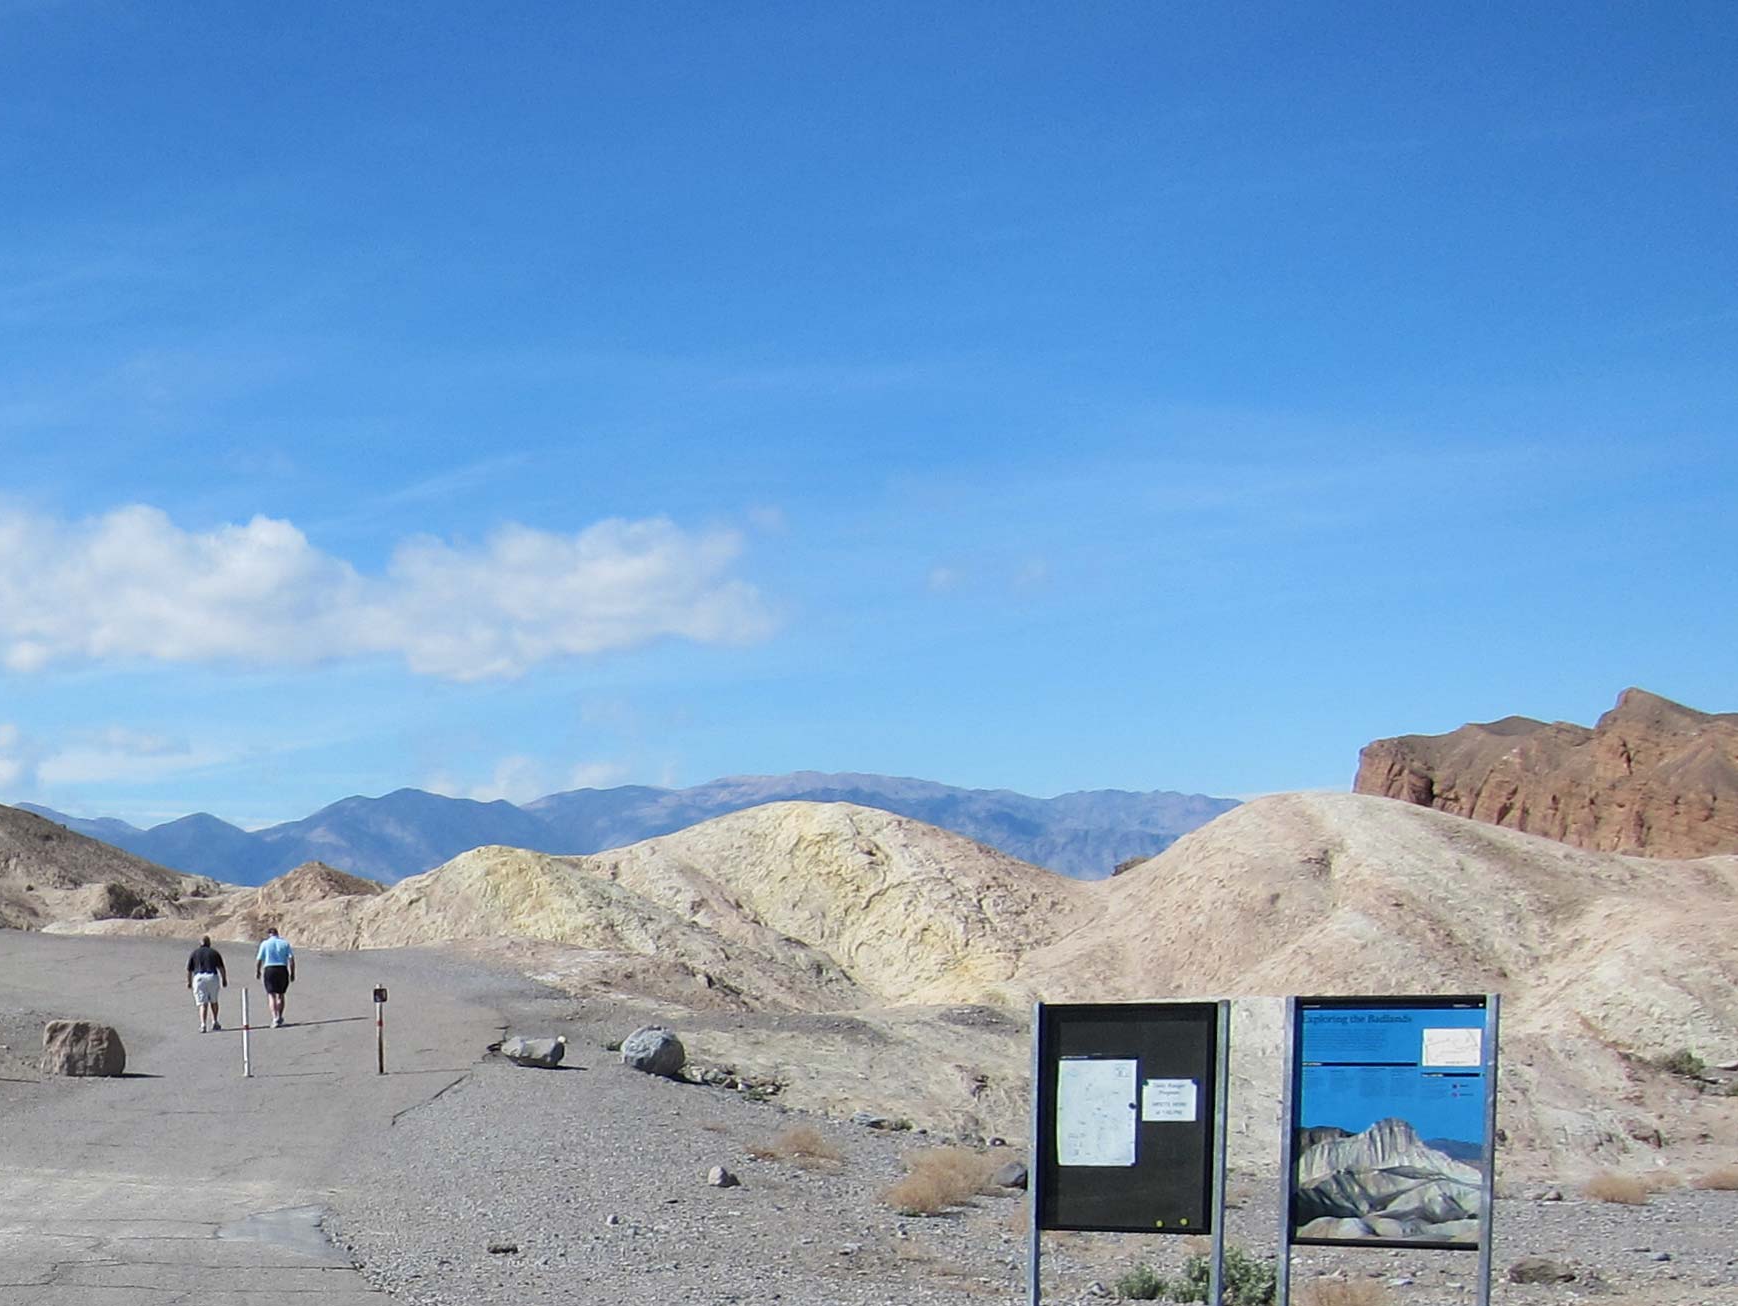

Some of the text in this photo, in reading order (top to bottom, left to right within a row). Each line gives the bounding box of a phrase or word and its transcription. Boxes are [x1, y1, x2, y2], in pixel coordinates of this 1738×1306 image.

[1303, 1014, 1412, 1026] Exploring the Badlands
